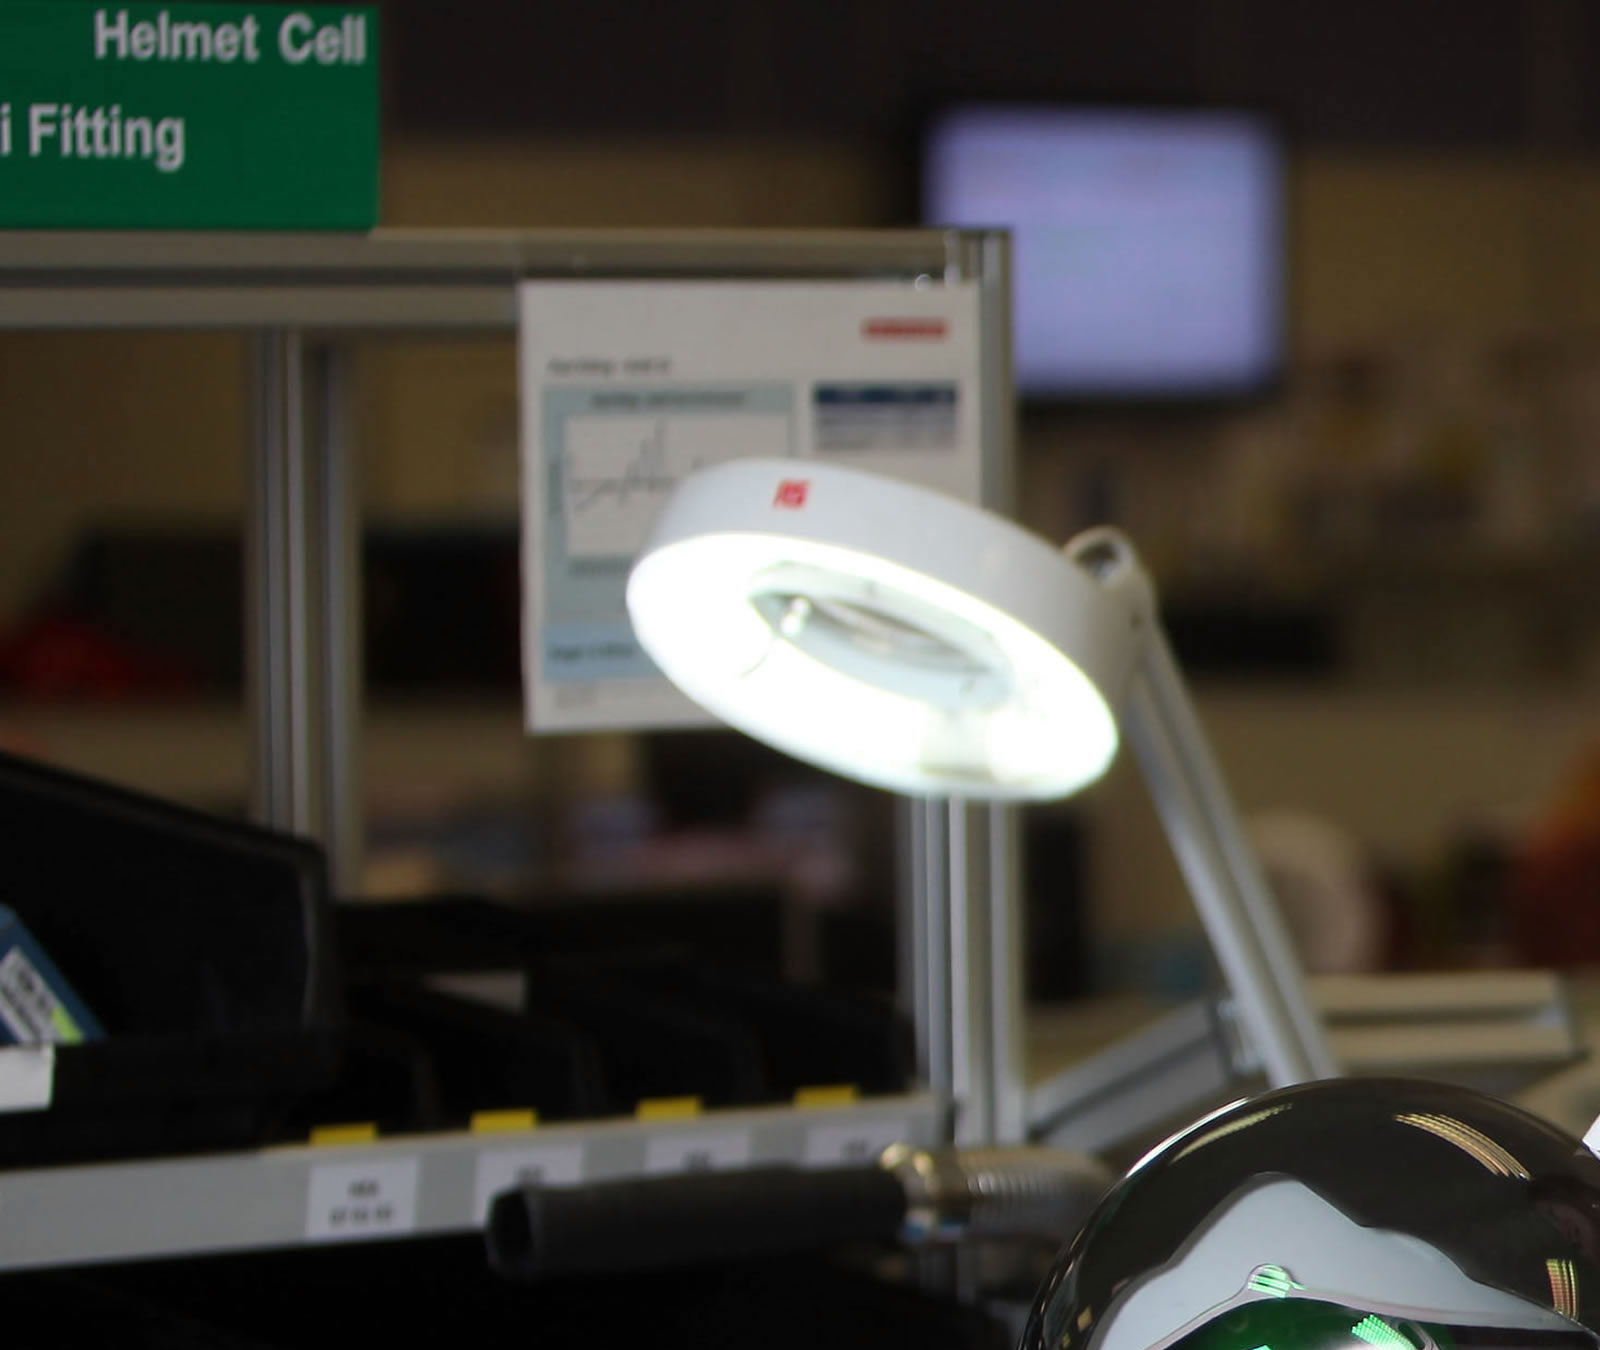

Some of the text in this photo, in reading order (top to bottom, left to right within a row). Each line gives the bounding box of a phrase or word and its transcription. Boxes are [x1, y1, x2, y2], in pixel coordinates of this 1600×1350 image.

[94, 9, 367, 65] Helmet Cell
[28, 102, 187, 173] Fitting
